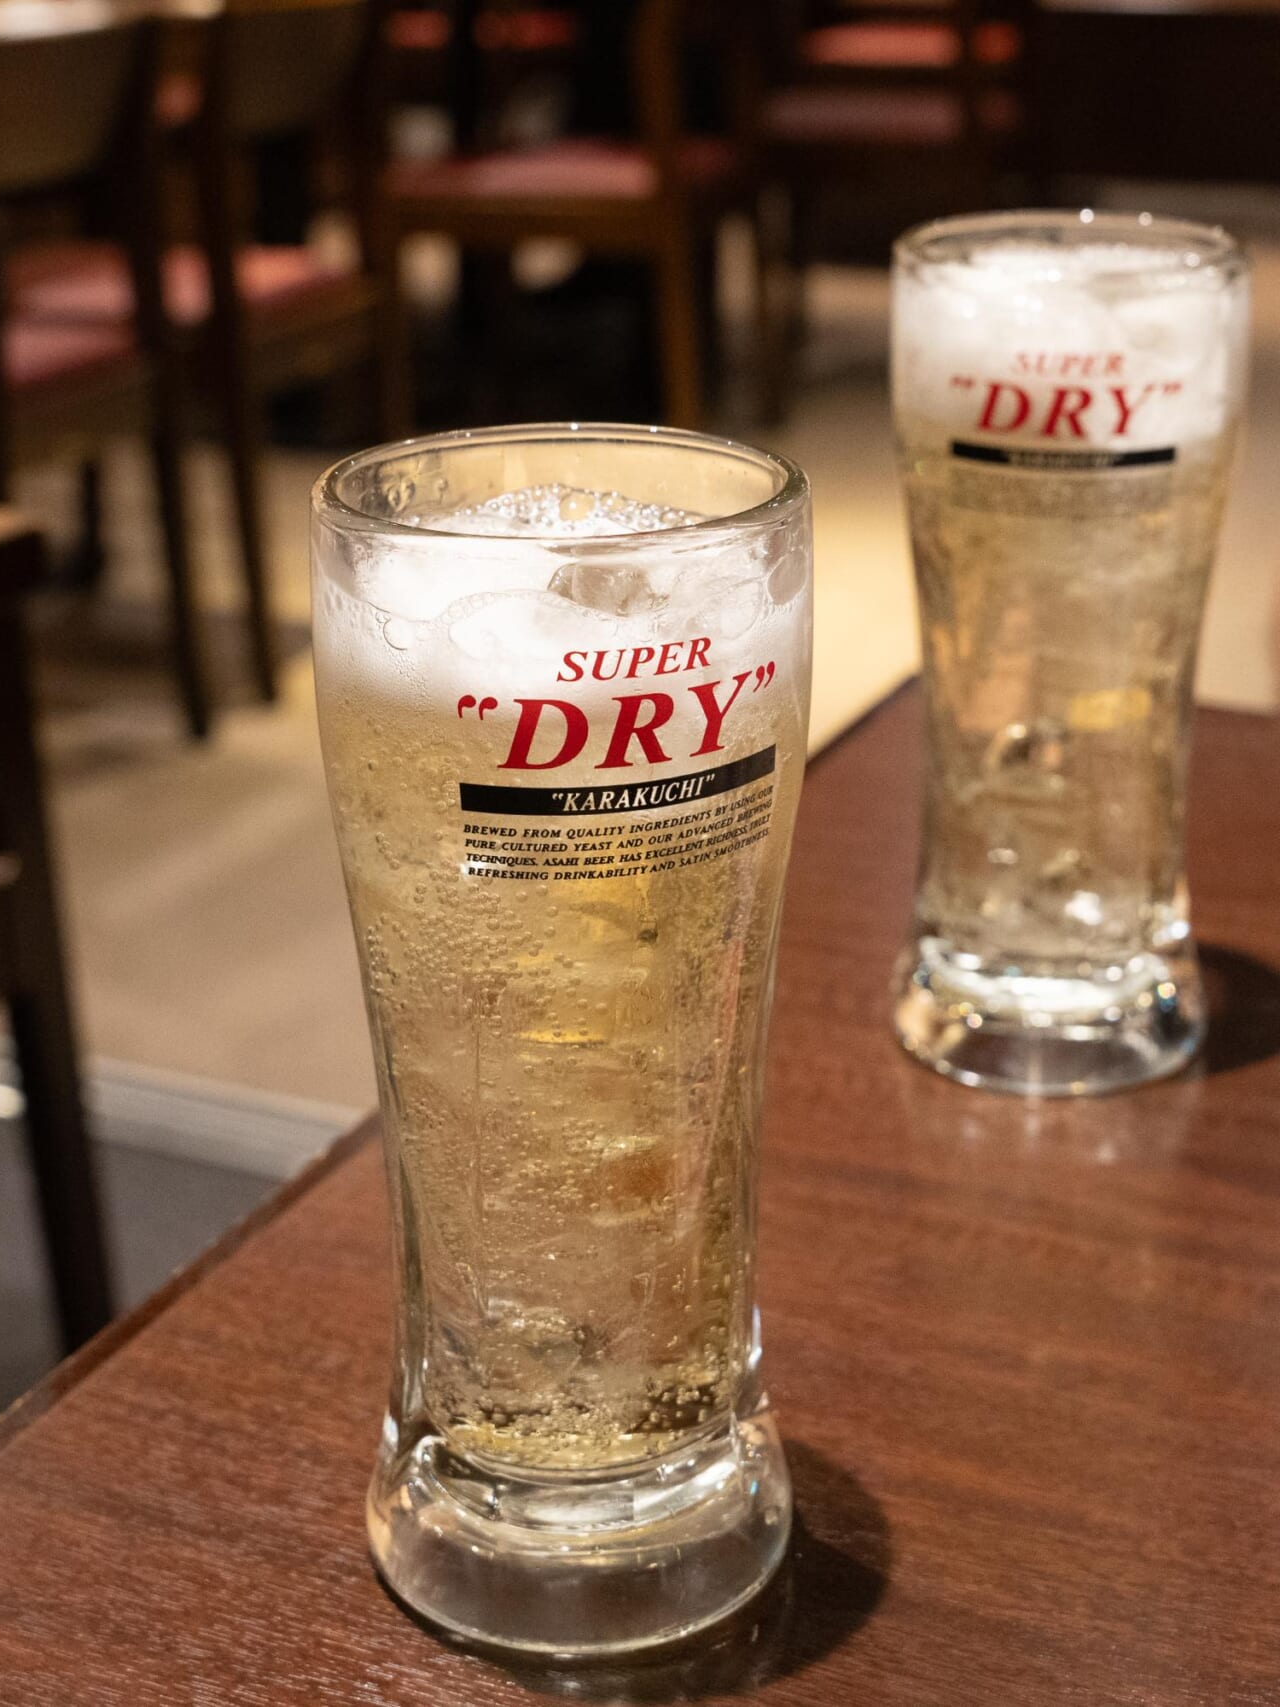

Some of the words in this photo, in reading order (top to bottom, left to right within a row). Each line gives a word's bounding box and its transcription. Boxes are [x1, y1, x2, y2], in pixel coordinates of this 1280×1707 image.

[1015, 352, 1125, 375] SUPER
[557, 636, 712, 683] SUPER
[457, 660, 776, 770] “DRY”
[463, 824, 517, 837] BREWED
[523, 828, 562, 838] FROM
[566, 826, 625, 839] QUALITY
[629, 810, 711, 834] INGREDIENTS
[715, 805, 728, 817] BY
[730, 795, 754, 811] USING
[758, 785, 774, 799] OUR
[551, 774, 716, 812] “KARAKUCHI”
[465, 838, 497, 850] PURE
[501, 841, 568, 852] CULTURED
[573, 841, 613, 852] YEAST
[617, 838, 643, 849] AND
[648, 833, 673, 846] OUR
[678, 817, 733, 839] ADVANCED
[737, 799, 773, 823] BREWING
[468, 867, 549, 880] REFRESHING
[553, 865, 648, 881] DRINKABILITY
[649, 861, 675, 873] AND
[679, 851, 711, 868] SATIN
[543, 858, 579, 867] ASAHI
[583, 855, 615, 866] BEER
[619, 850, 642, 863] HAS
[645, 840, 705, 860] EXCELLENT
